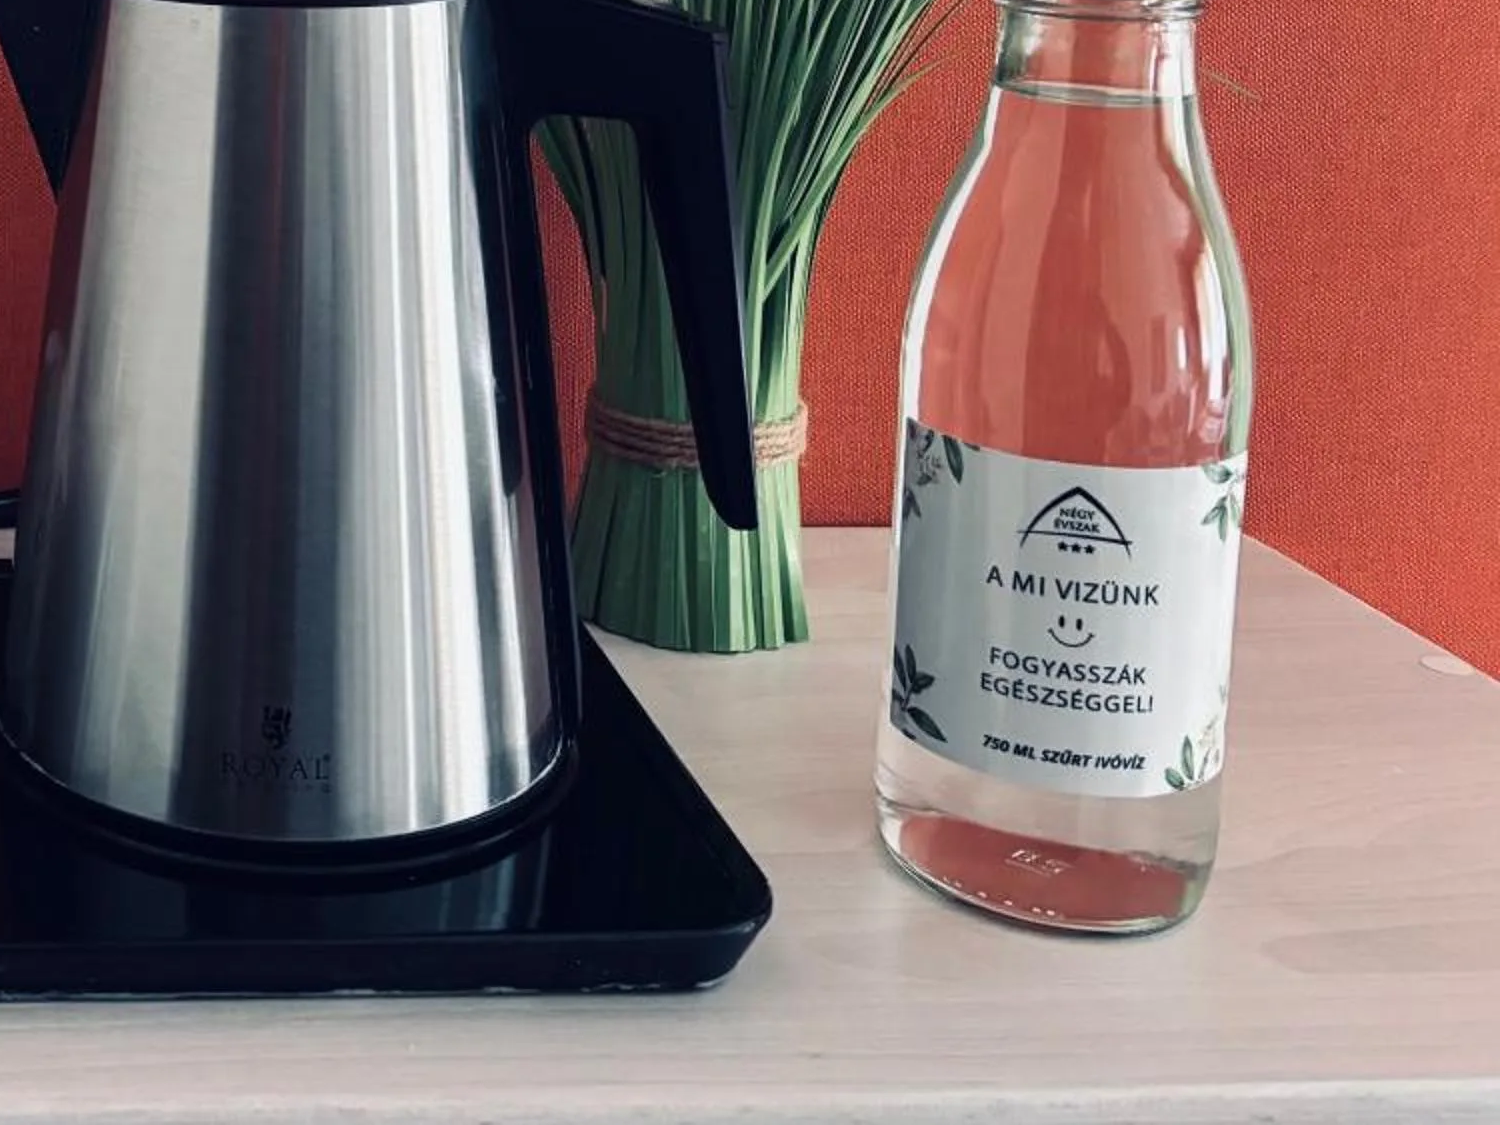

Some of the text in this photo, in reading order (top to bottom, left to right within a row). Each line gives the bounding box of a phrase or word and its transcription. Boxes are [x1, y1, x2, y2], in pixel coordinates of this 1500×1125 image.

[1054, 518, 1100, 533] ÉVSZAK
[1059, 507, 1095, 521] NÉGY
[986, 565, 1159, 606] A MI VIZÜNK
[989, 646, 1146, 686] FOGYASSZÁK
[980, 672, 1153, 713] EGÉSZSÉGGEL!
[982, 734, 1010, 752] 750
[1014, 743, 1036, 760] ML
[222, 752, 330, 780] ROYAL
